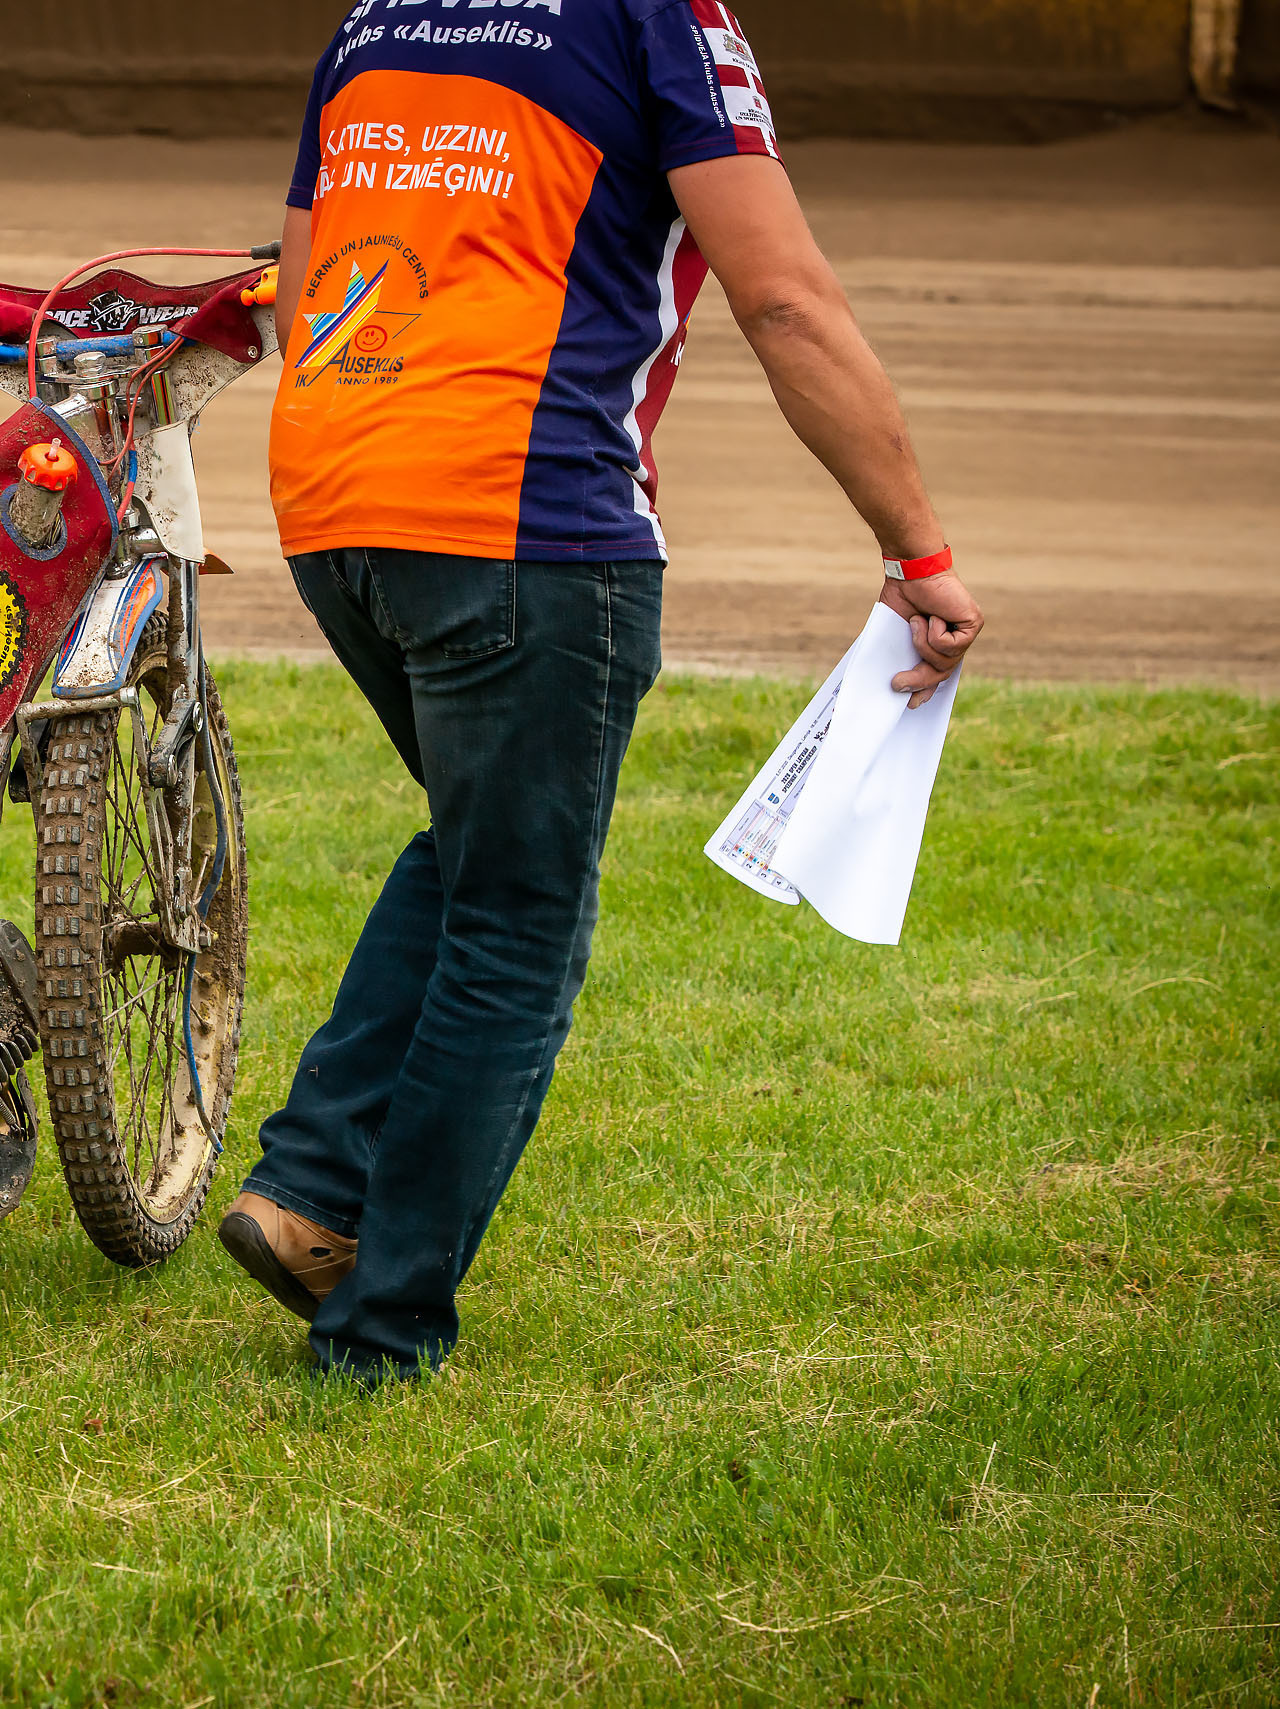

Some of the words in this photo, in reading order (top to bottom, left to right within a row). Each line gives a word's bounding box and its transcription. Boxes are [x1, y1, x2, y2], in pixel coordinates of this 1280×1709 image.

[392, 20, 553, 50] «Auseklis»
[421, 124, 510, 163] UZZINI,
[385, 156, 515, 199] IZMĒĢINI!
[340, 240, 356, 256] UN
[358, 234, 404, 250] JAUNIEŠU
[402, 248, 428, 299] CENTRS
[328, 340, 404, 374] AUSEKLIS
[295, 374, 309, 388] IK
[374, 376, 398, 384] 1989
